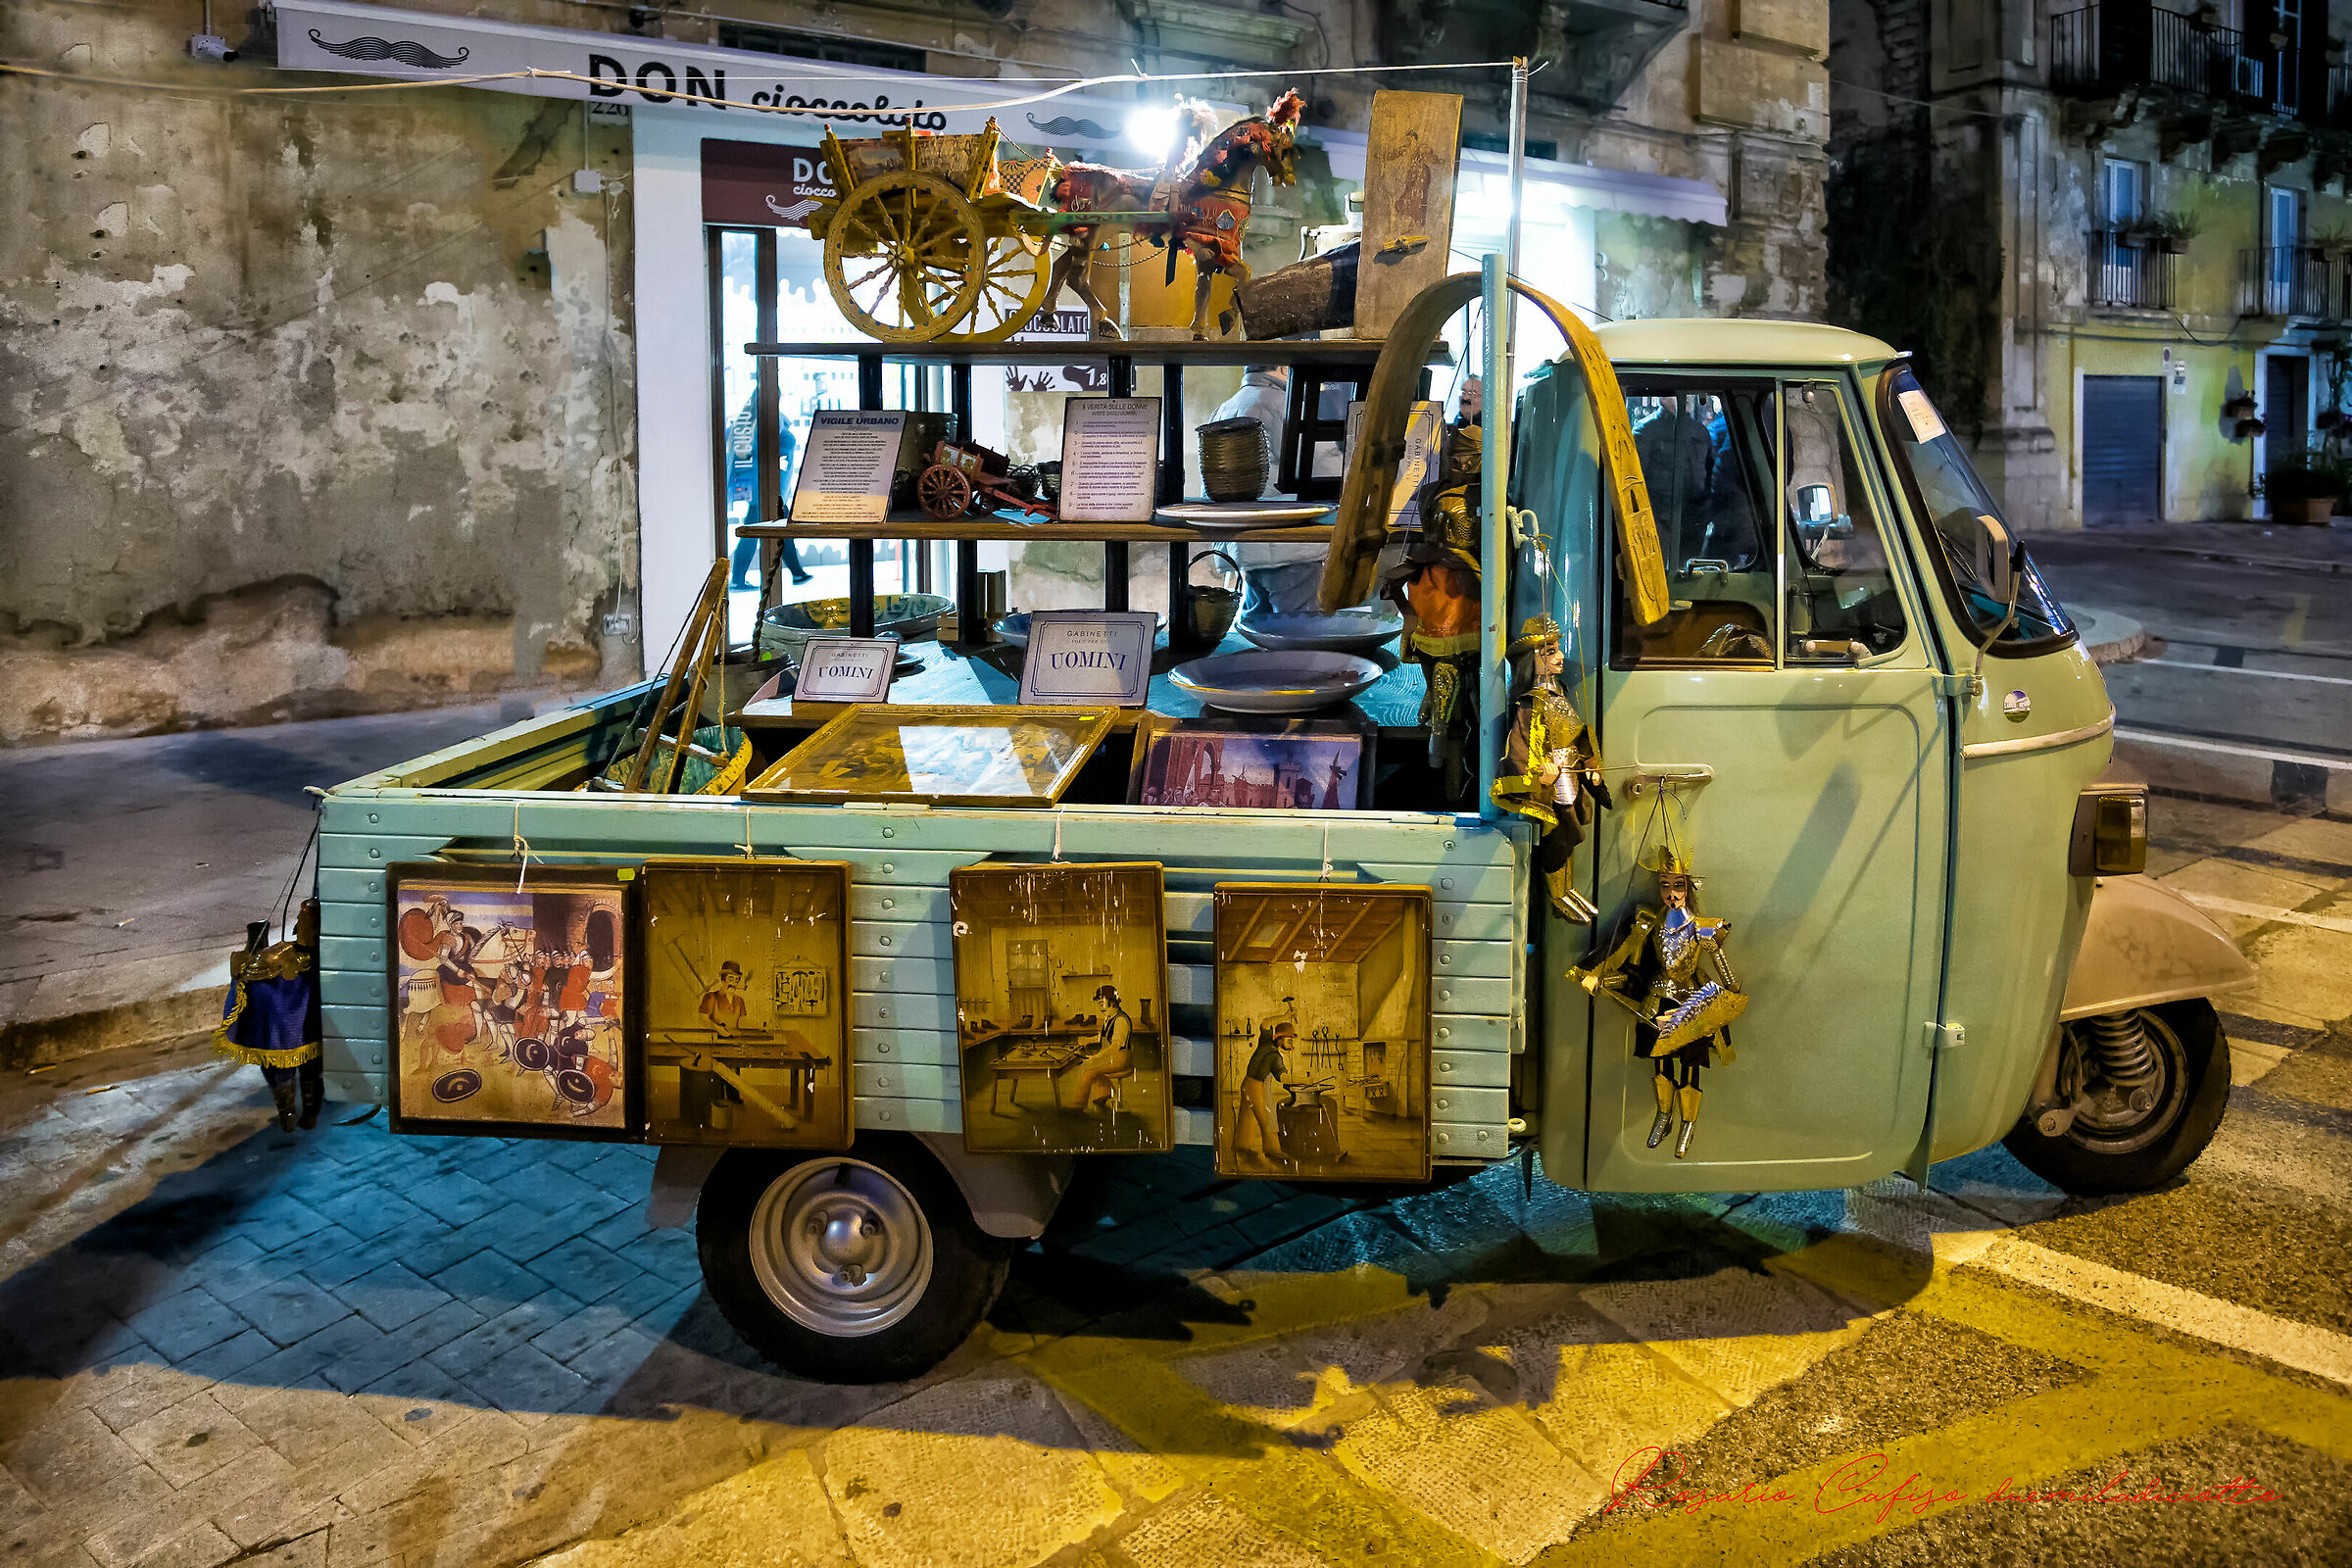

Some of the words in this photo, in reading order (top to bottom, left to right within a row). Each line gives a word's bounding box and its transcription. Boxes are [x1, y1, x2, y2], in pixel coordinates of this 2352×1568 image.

[588, 53, 727, 111] DON
[751, 84, 947, 131] cioccolato
[793, 158, 833, 185] DO
[793, 182, 837, 198] ciocco
[1086, 368, 1107, 387] 1,8
[1412, 438, 1421, 488] GABINETTI
[1051, 650, 1128, 670] UOMINI
[817, 665, 873, 680] UOMINI
